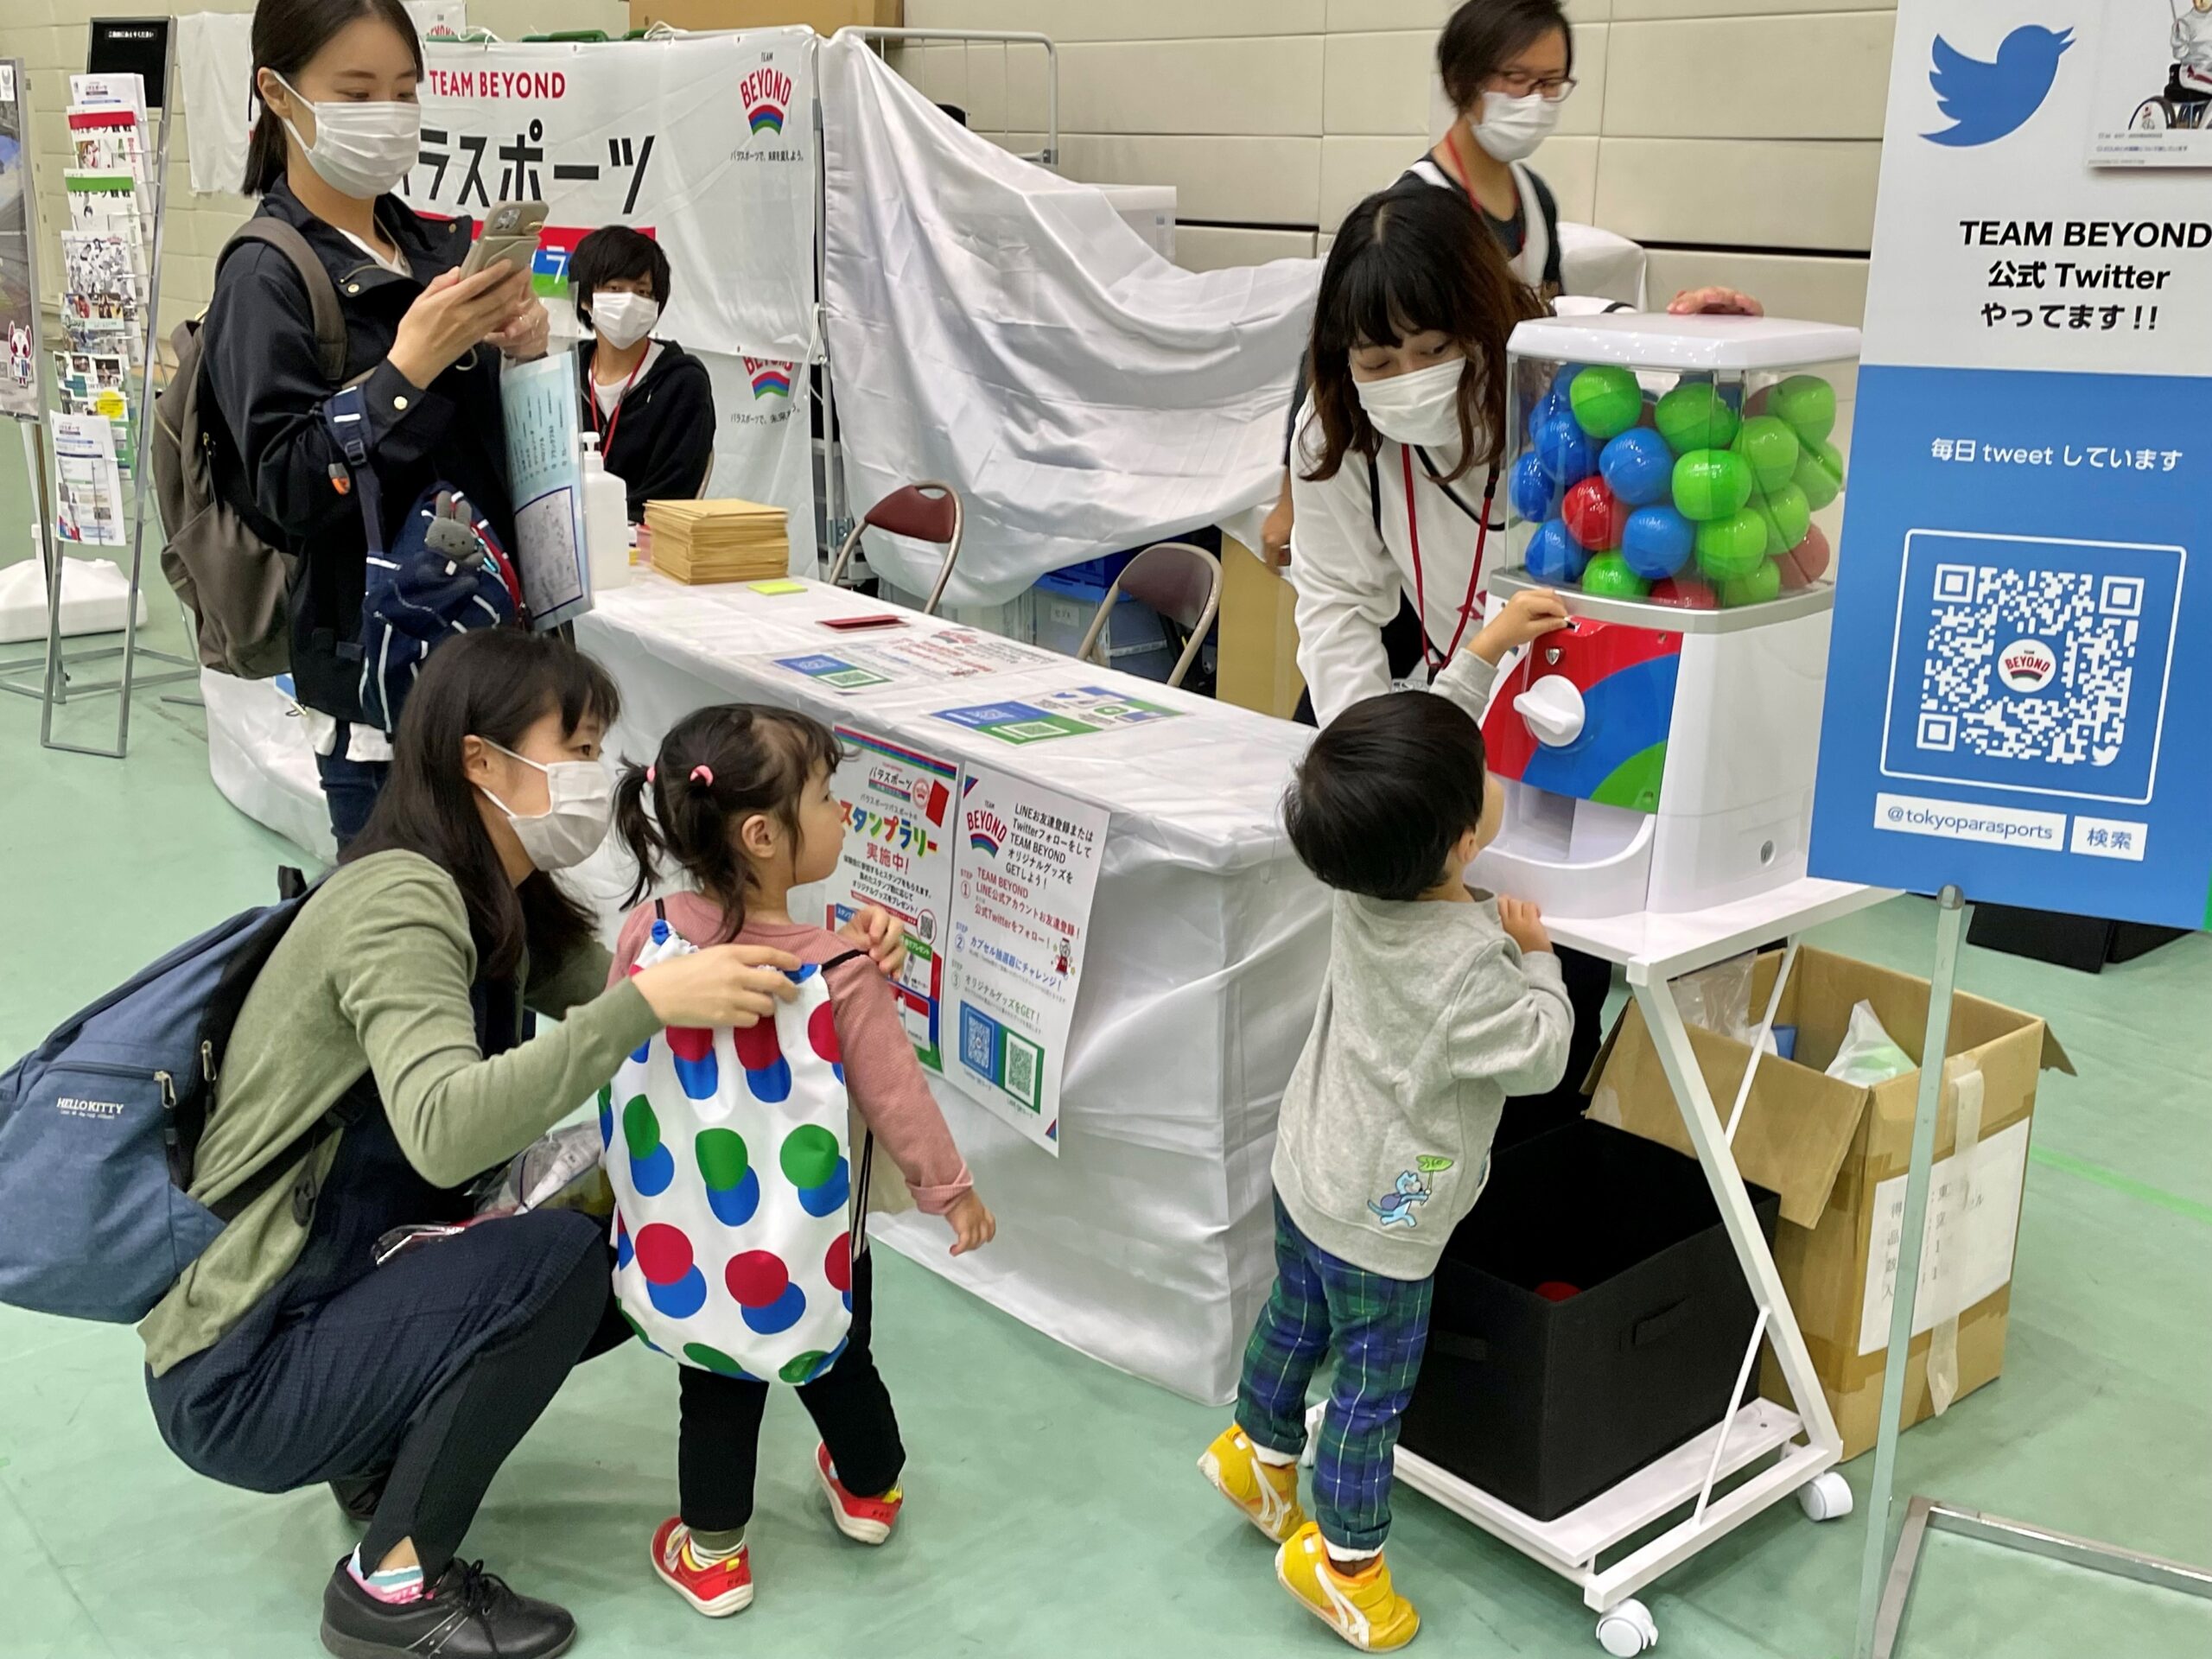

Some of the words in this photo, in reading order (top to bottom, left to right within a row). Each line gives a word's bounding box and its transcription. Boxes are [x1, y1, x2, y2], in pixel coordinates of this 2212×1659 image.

[429, 70, 474, 98] TEAM
[479, 72, 566, 99] BEYOND
[741, 68, 791, 110] BEYOND
[403, 118, 656, 214] ラスポーツ
[1959, 220, 2054, 246] TEAM
[2063, 221, 2212, 249] BEYOND
[1987, 260, 2047, 289] 公式
[2055, 263, 2171, 289] Twitter
[1931, 438, 1976, 462] 毎日
[1983, 443, 2054, 466] tweet
[2063, 445, 2183, 472] しています
[2005, 657, 2050, 672] BEYOND
[869, 766, 912, 790] パラスポーツ
[840, 799, 938, 857] スタンプラリー
[967, 810, 1007, 843] BEYOND
[1013, 817, 1092, 859] Twitterフォローをして
[1887, 805, 2053, 840] @tokyoparasports
[2087, 827, 2133, 851] 検索
[1010, 833, 1032, 850] TEAM
[1033, 842, 1066, 864] BEYOND
[977, 867, 997, 886] TEAM
[998, 876, 1029, 899] BEYOND
[1008, 849, 1073, 885] オリジナルグッズを
